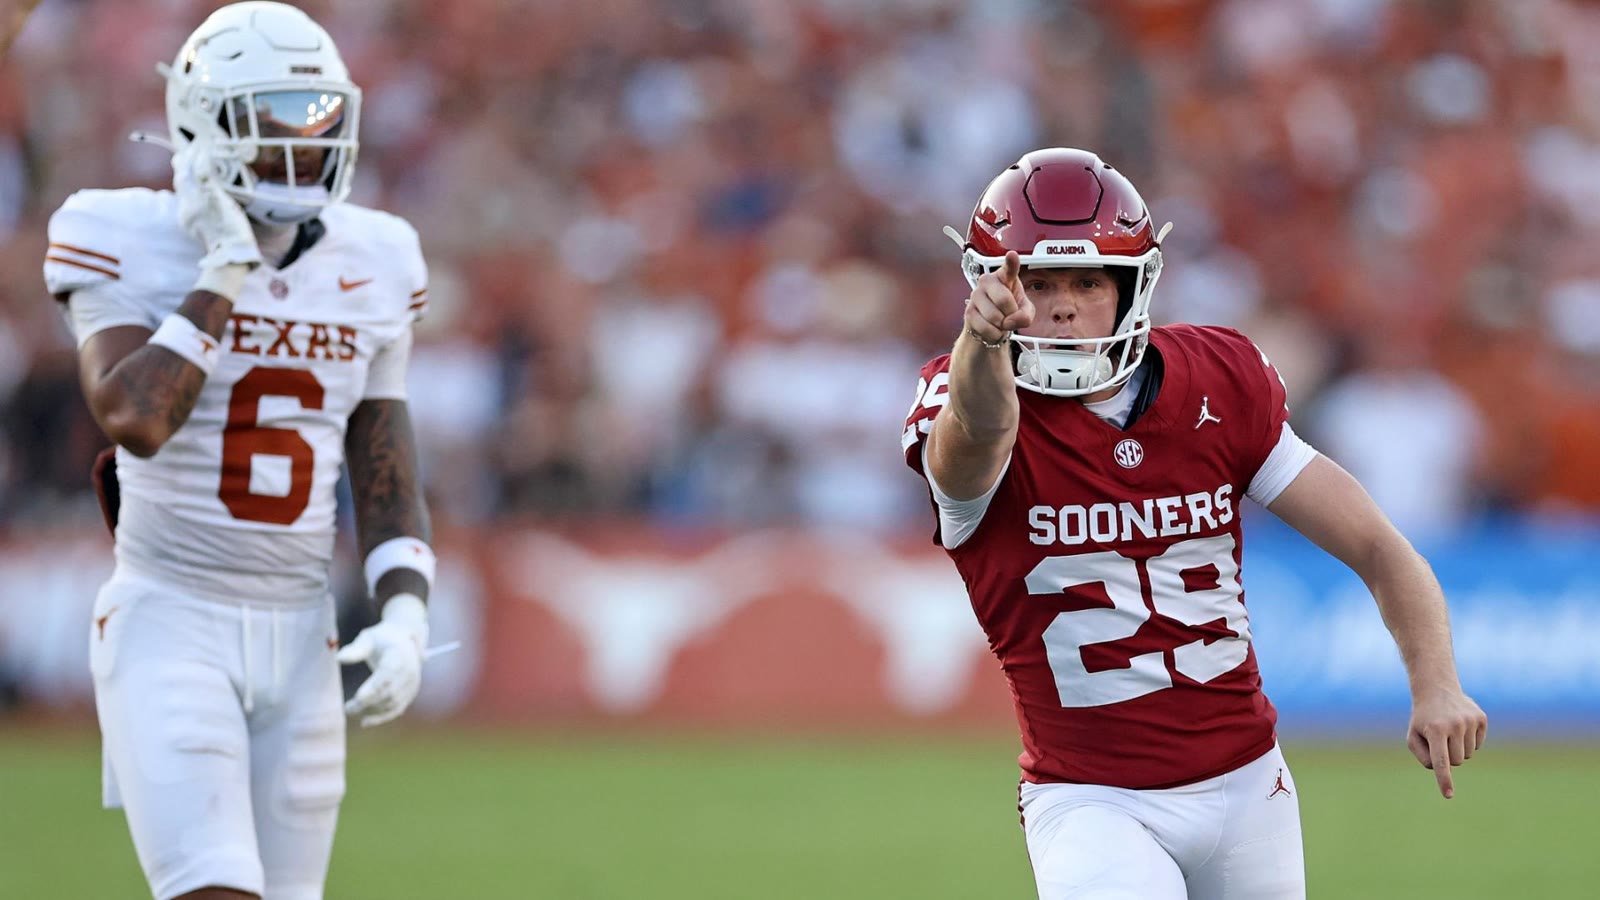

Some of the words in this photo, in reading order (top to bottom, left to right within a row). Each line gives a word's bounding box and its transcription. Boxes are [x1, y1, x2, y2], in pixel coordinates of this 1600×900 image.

[1046, 245, 1086, 255] OKLAHOMA
[229, 313, 358, 361] EXAS
[218, 367, 325, 526] 6
[1116, 440, 1142, 467] SEC
[1028, 483, 1234, 545] SOONERS
[1024, 532, 1251, 708] 29
